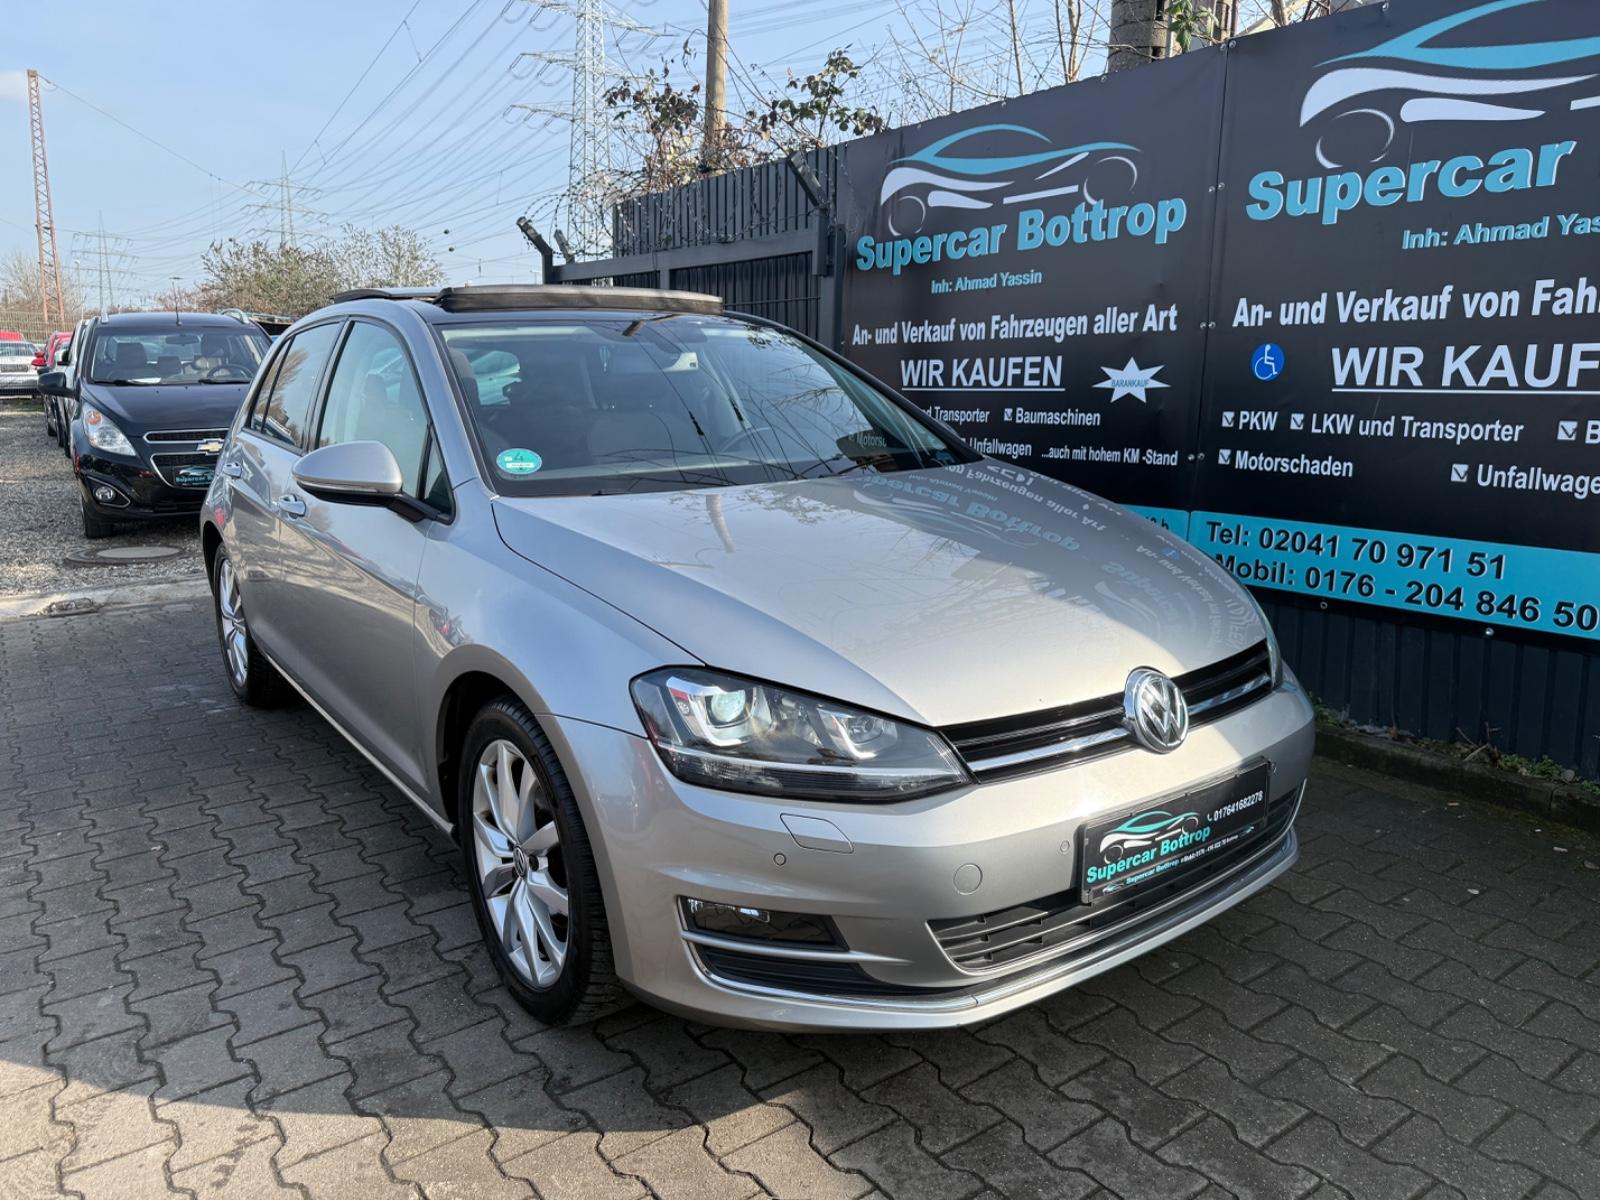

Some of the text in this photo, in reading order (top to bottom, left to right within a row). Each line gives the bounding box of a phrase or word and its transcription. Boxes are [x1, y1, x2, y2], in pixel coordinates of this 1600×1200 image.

[1245, 140, 1577, 225] Supercar
[856, 197, 1187, 275] Supercar Bottrop
[1402, 229, 1449, 250] Inh:
[1453, 215, 1550, 246] Ahmad
[931, 269, 1042, 294] Inh: Ahmad Yassin
[1232, 277, 1600, 327] An- und Verkauf von Fah
[852, 303, 1178, 345] An- und Verkauf von Fahrzeugen aller Art
[900, 355, 1063, 387] WIR KAUFEN
[1331, 343, 1600, 388] WIR KAUF
[933, 405, 991, 426] Transporter
[1015, 407, 1101, 427] Baumaschinen
[1238, 410, 1279, 432] PKW
[1311, 413, 1524, 446] LKW und Transporter
[969, 437, 1032, 459] Unfallwagen
[1072, 446, 1087, 461] mit
[1088, 446, 1121, 462] hohem
[1123, 448, 1140, 463] KM
[1234, 450, 1354, 478] Motorschaden
[1206, 520, 1506, 580] Tel: 02041 70 971 51
[1215, 553, 1296, 586] Mobil:
[1304, 566, 1376, 598] 0176
[1404, 580, 1465, 612] 204
[1475, 590, 1541, 623] 846
[1552, 601, 1600, 632] 50
[1086, 847, 1158, 884] Supercar
[1160, 824, 1212, 857] Bottrop
